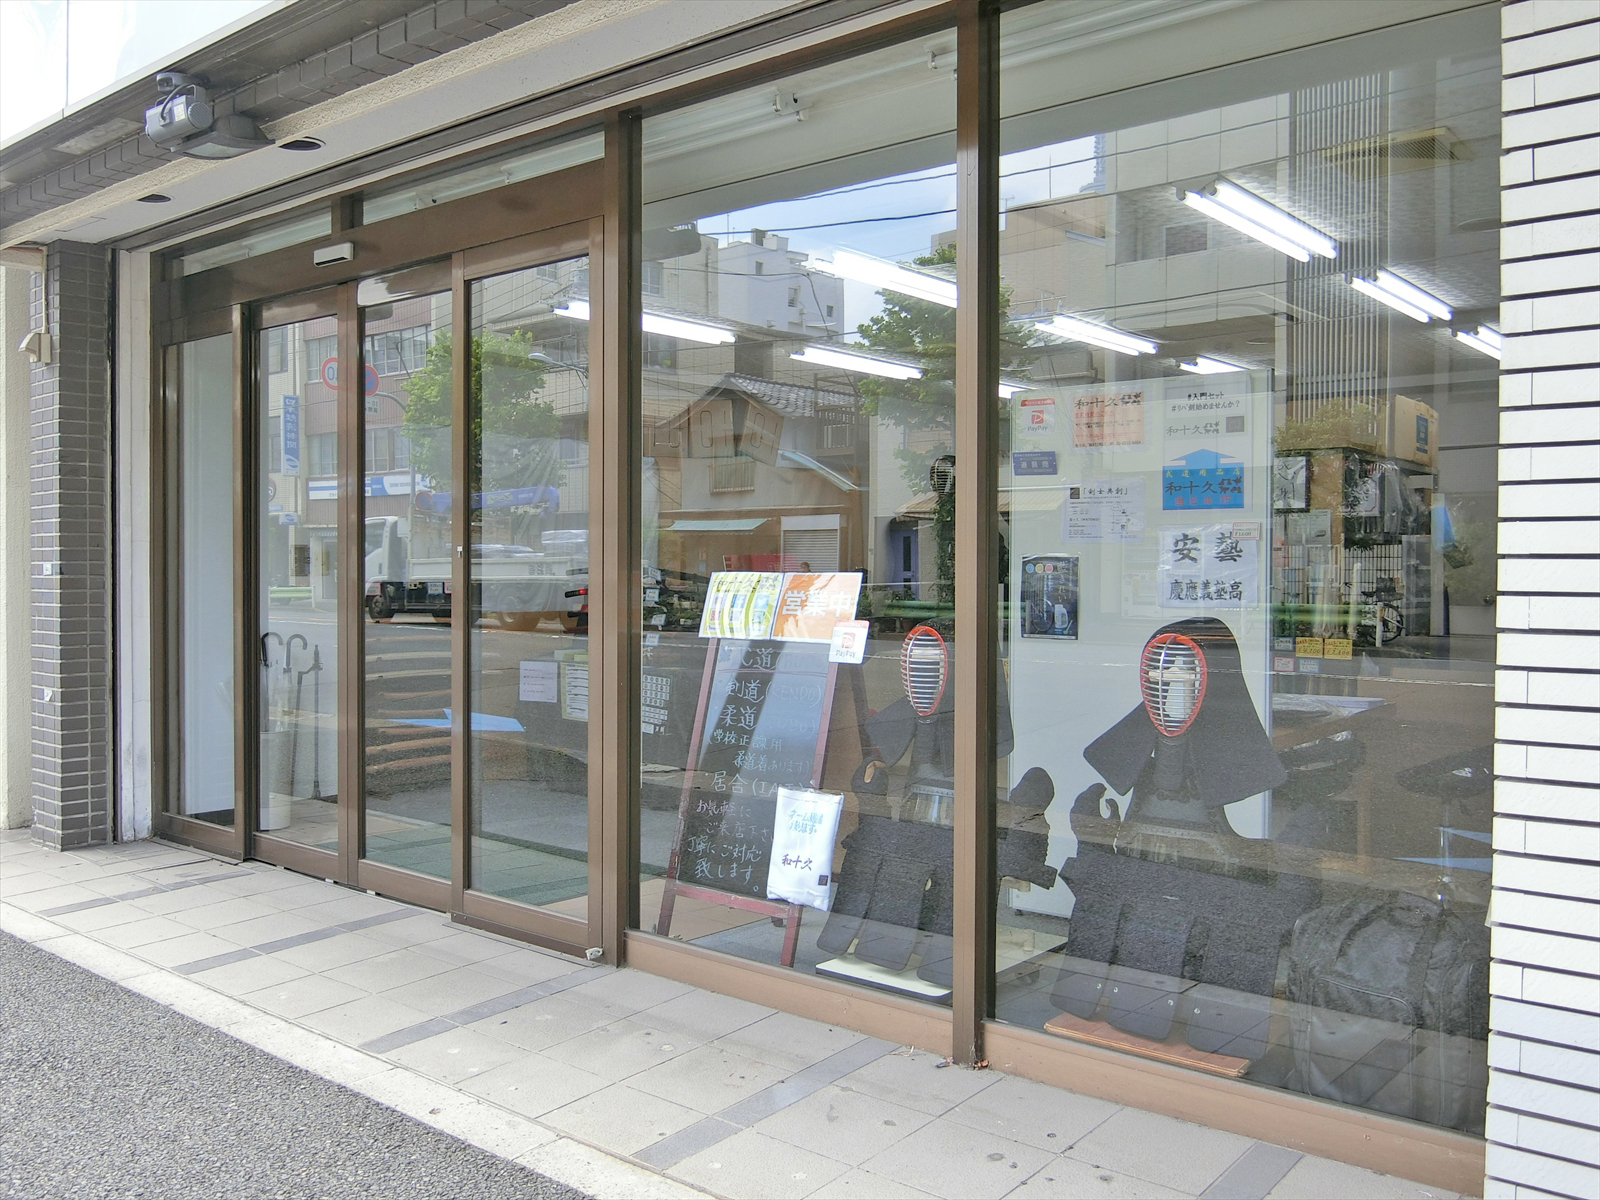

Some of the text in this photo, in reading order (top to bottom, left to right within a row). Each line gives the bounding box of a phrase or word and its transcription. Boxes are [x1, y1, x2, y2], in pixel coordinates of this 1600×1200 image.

[1166, 423, 1203, 436] 和十久
[1165, 480, 1218, 495] 和十久
[782, 590, 852, 618] 営業中
[835, 649, 857, 659] PayPay
[696, 799, 752, 819] お気軽に
[781, 853, 813, 872] 和十久
